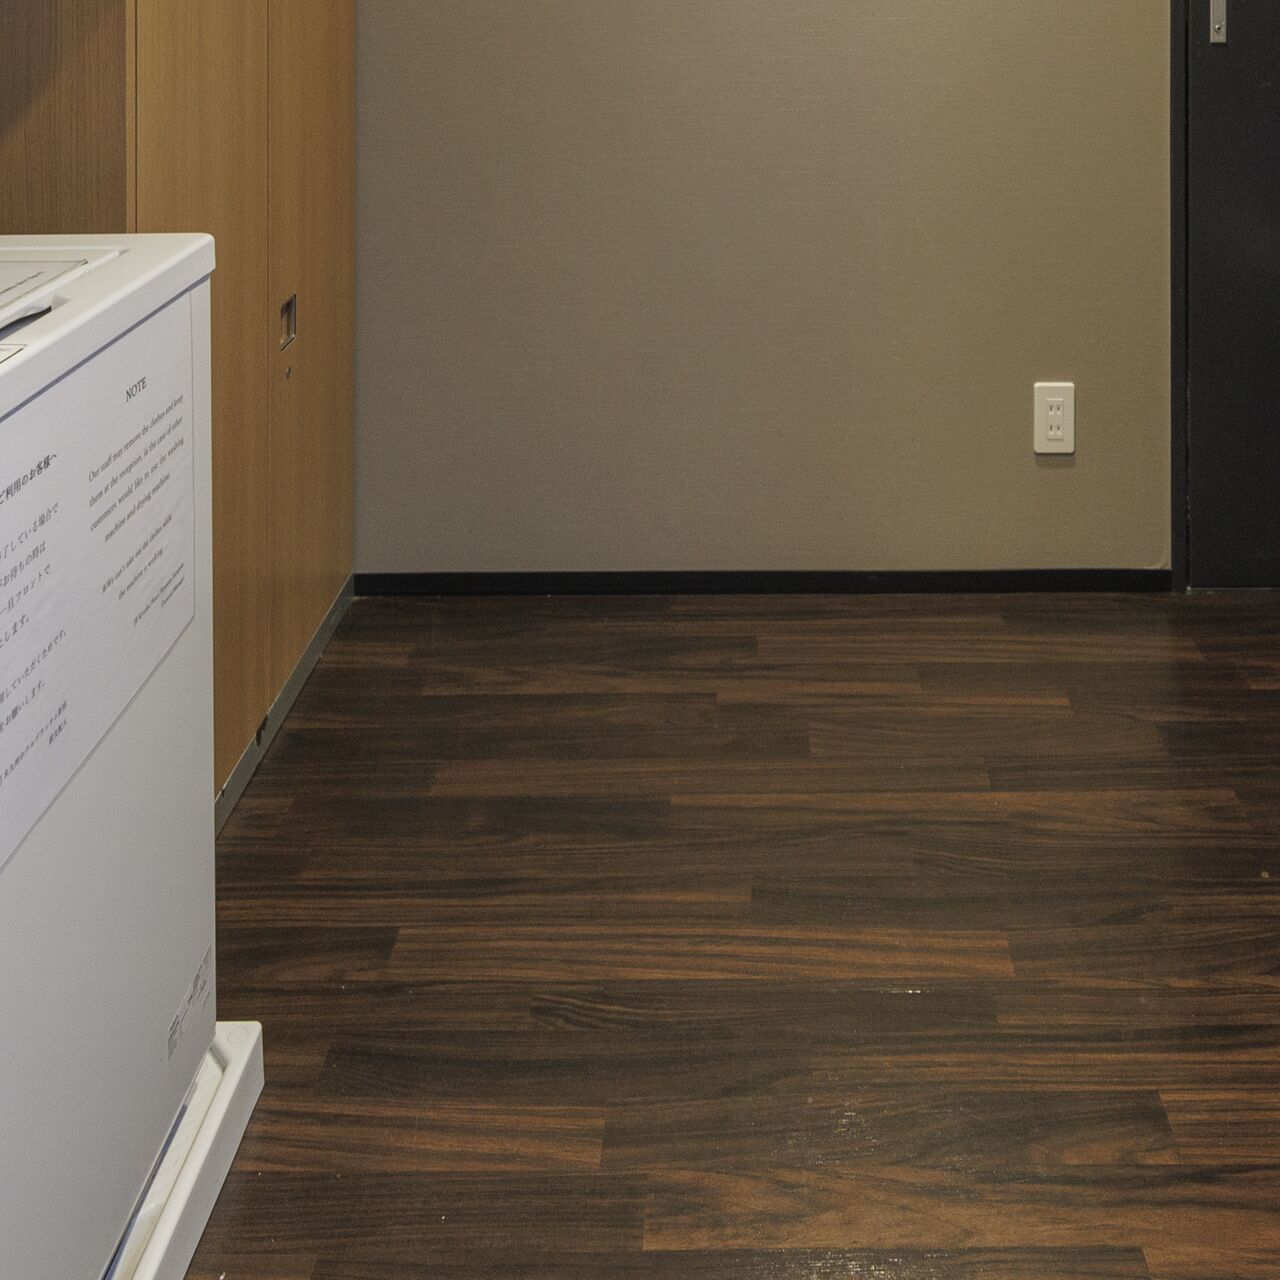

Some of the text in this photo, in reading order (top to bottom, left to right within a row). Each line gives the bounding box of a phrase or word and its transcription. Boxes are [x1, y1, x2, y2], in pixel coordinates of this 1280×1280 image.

[126, 375, 146, 403] NOTE
[89, 464, 99, 484] Our
[101, 452, 112, 472] staff
[112, 446, 122, 464] may
[123, 430, 141, 452] remove
[149, 407, 164, 429] clothes
[165, 399, 173, 415] and
[89, 486, 103, 508] them
[110, 472, 118, 489] the
[157, 430, 166, 445] case
[90, 500, 116, 533] customers
[118, 482, 132, 506] would
[134, 472, 143, 491] like
[167, 433, 184, 460] washing
[105, 488, 151, 543] machine and drying
